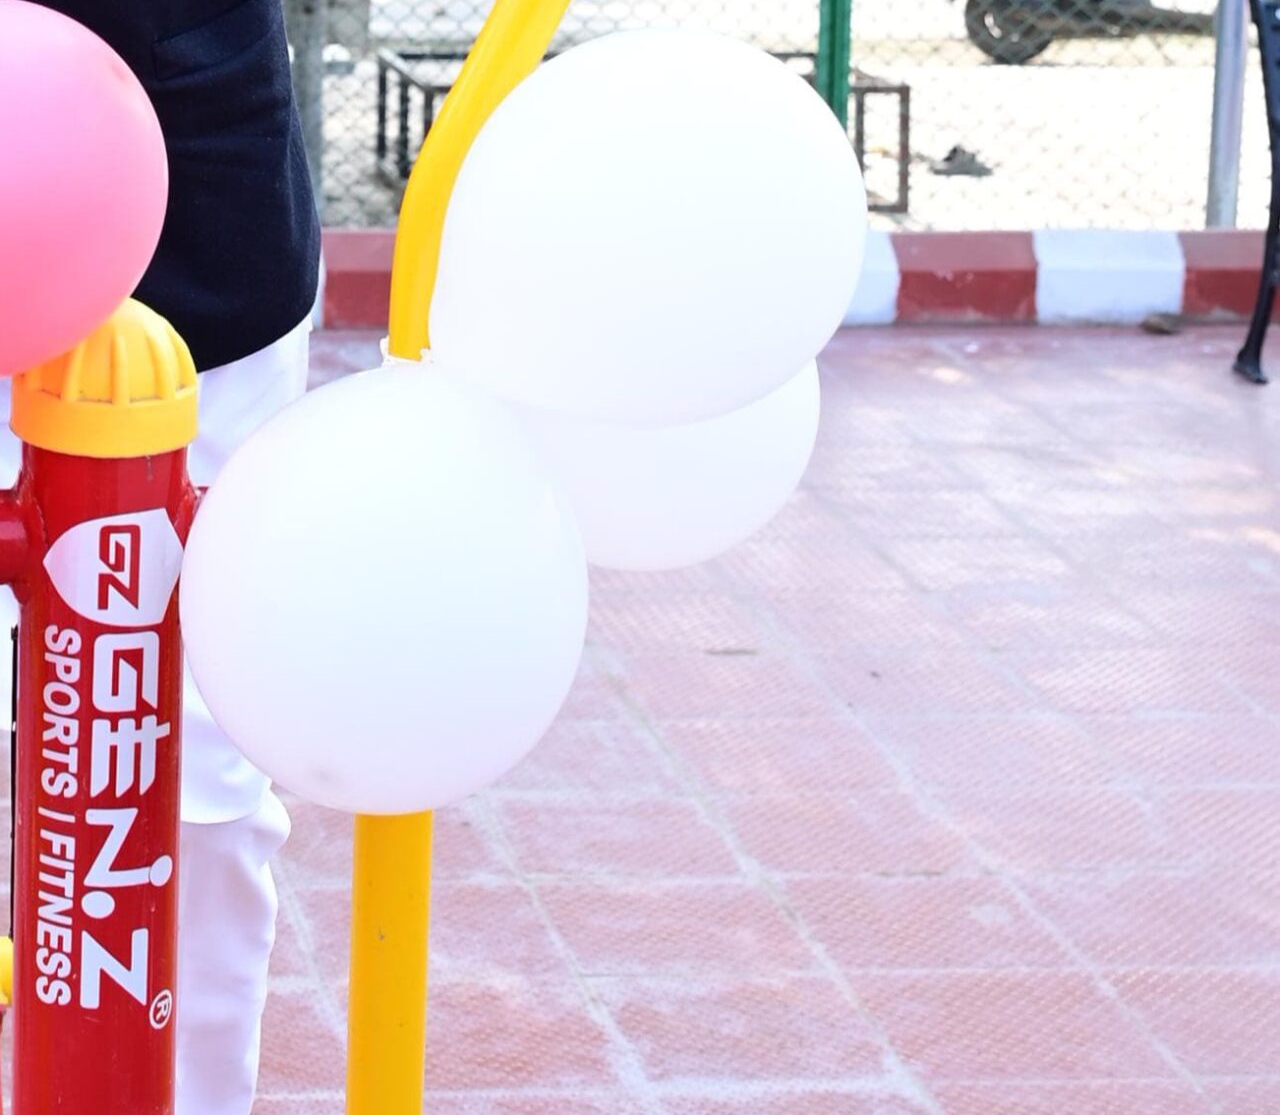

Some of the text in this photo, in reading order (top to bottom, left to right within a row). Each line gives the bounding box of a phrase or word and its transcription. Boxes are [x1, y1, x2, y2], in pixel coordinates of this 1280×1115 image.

[97, 524, 141, 611] GZ
[42, 624, 82, 799] SPORTS
[35, 828, 77, 1006] FITNESS
